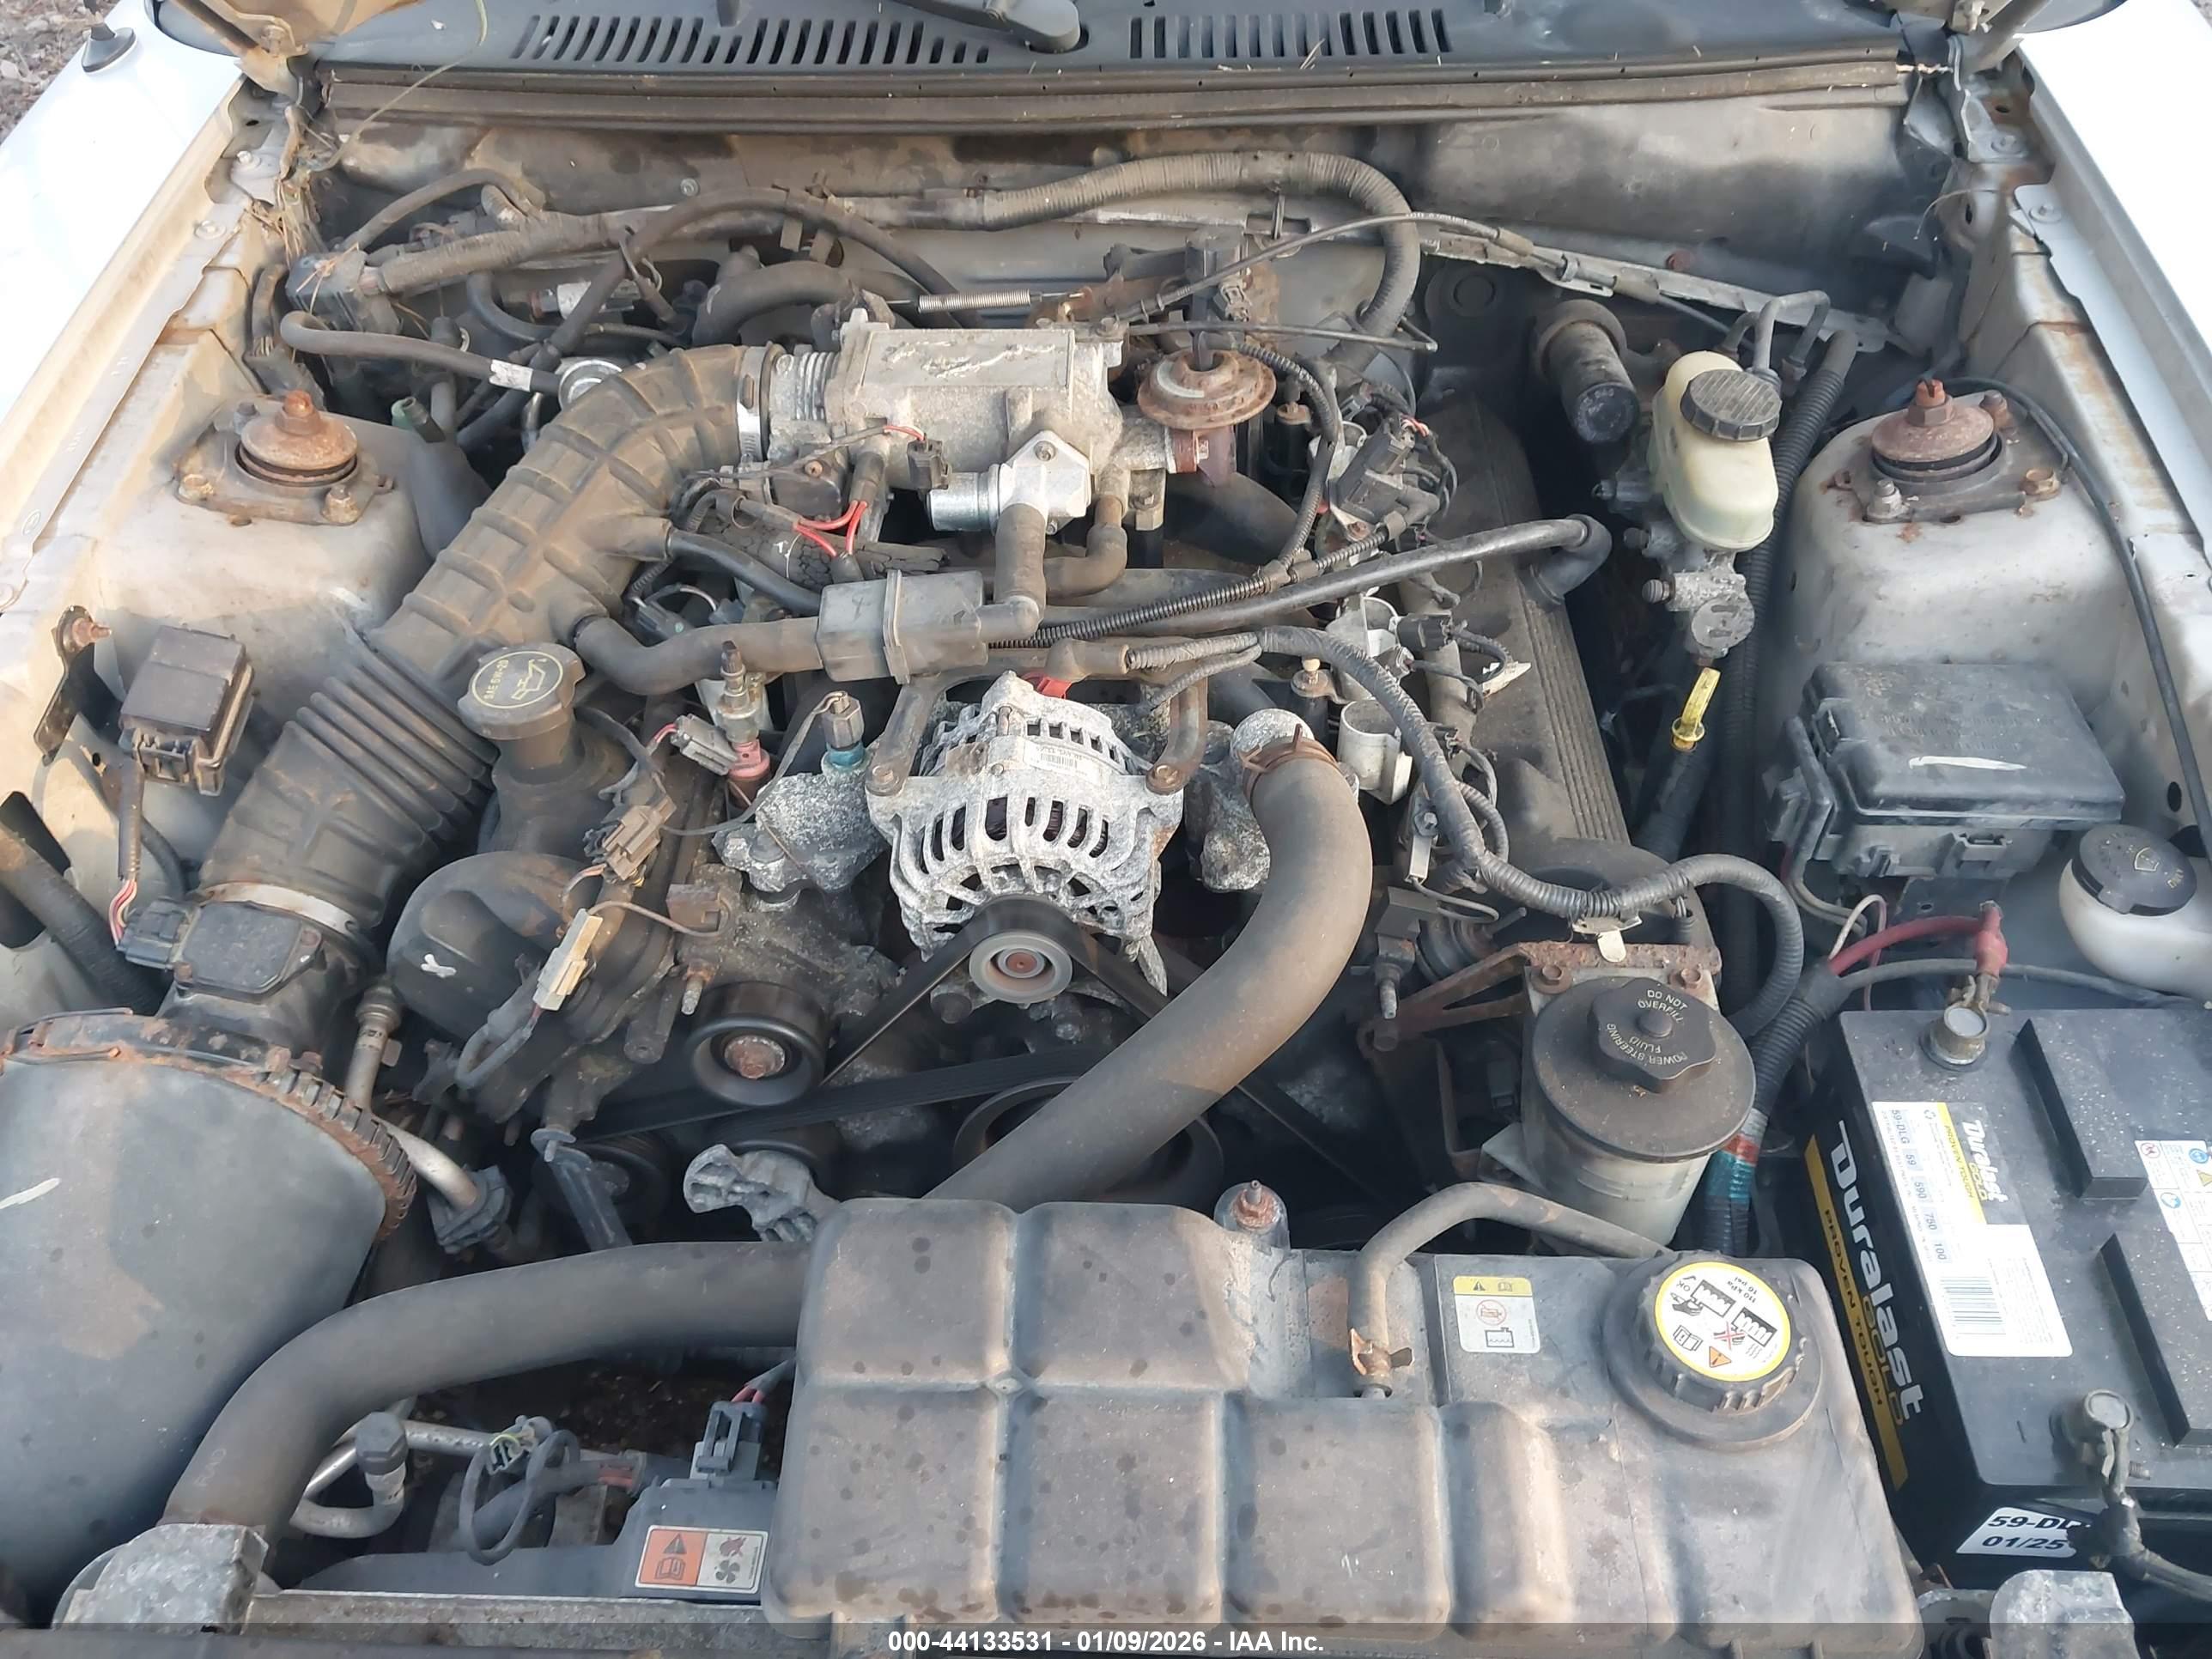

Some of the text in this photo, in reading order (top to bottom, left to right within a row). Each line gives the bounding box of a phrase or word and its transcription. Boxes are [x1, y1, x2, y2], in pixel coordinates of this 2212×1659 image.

[1647, 989, 1688, 1011] DO NOT
[1637, 1000, 1685, 1024] OVERFILL
[1606, 1022, 1688, 1066] POWER STEERING
[1628, 1036, 1662, 1054] FLUID
[1905, 1154, 1917, 1166] 59
[1961, 1120, 2009, 1203] Duralast
[1915, 1182, 1927, 1200] 590
[1935, 1243, 1947, 1261] 100
[1830, 1121, 1924, 1419] Duralast
[1676, 1280, 1691, 1292] OK
[1743, 1292, 1756, 1304] 110
[1824, 1209, 1883, 1406] PROVEN TOUGH
[1863, 1295, 1904, 1426] GOLD
[1982, 1535, 2069, 1550] 01/25
